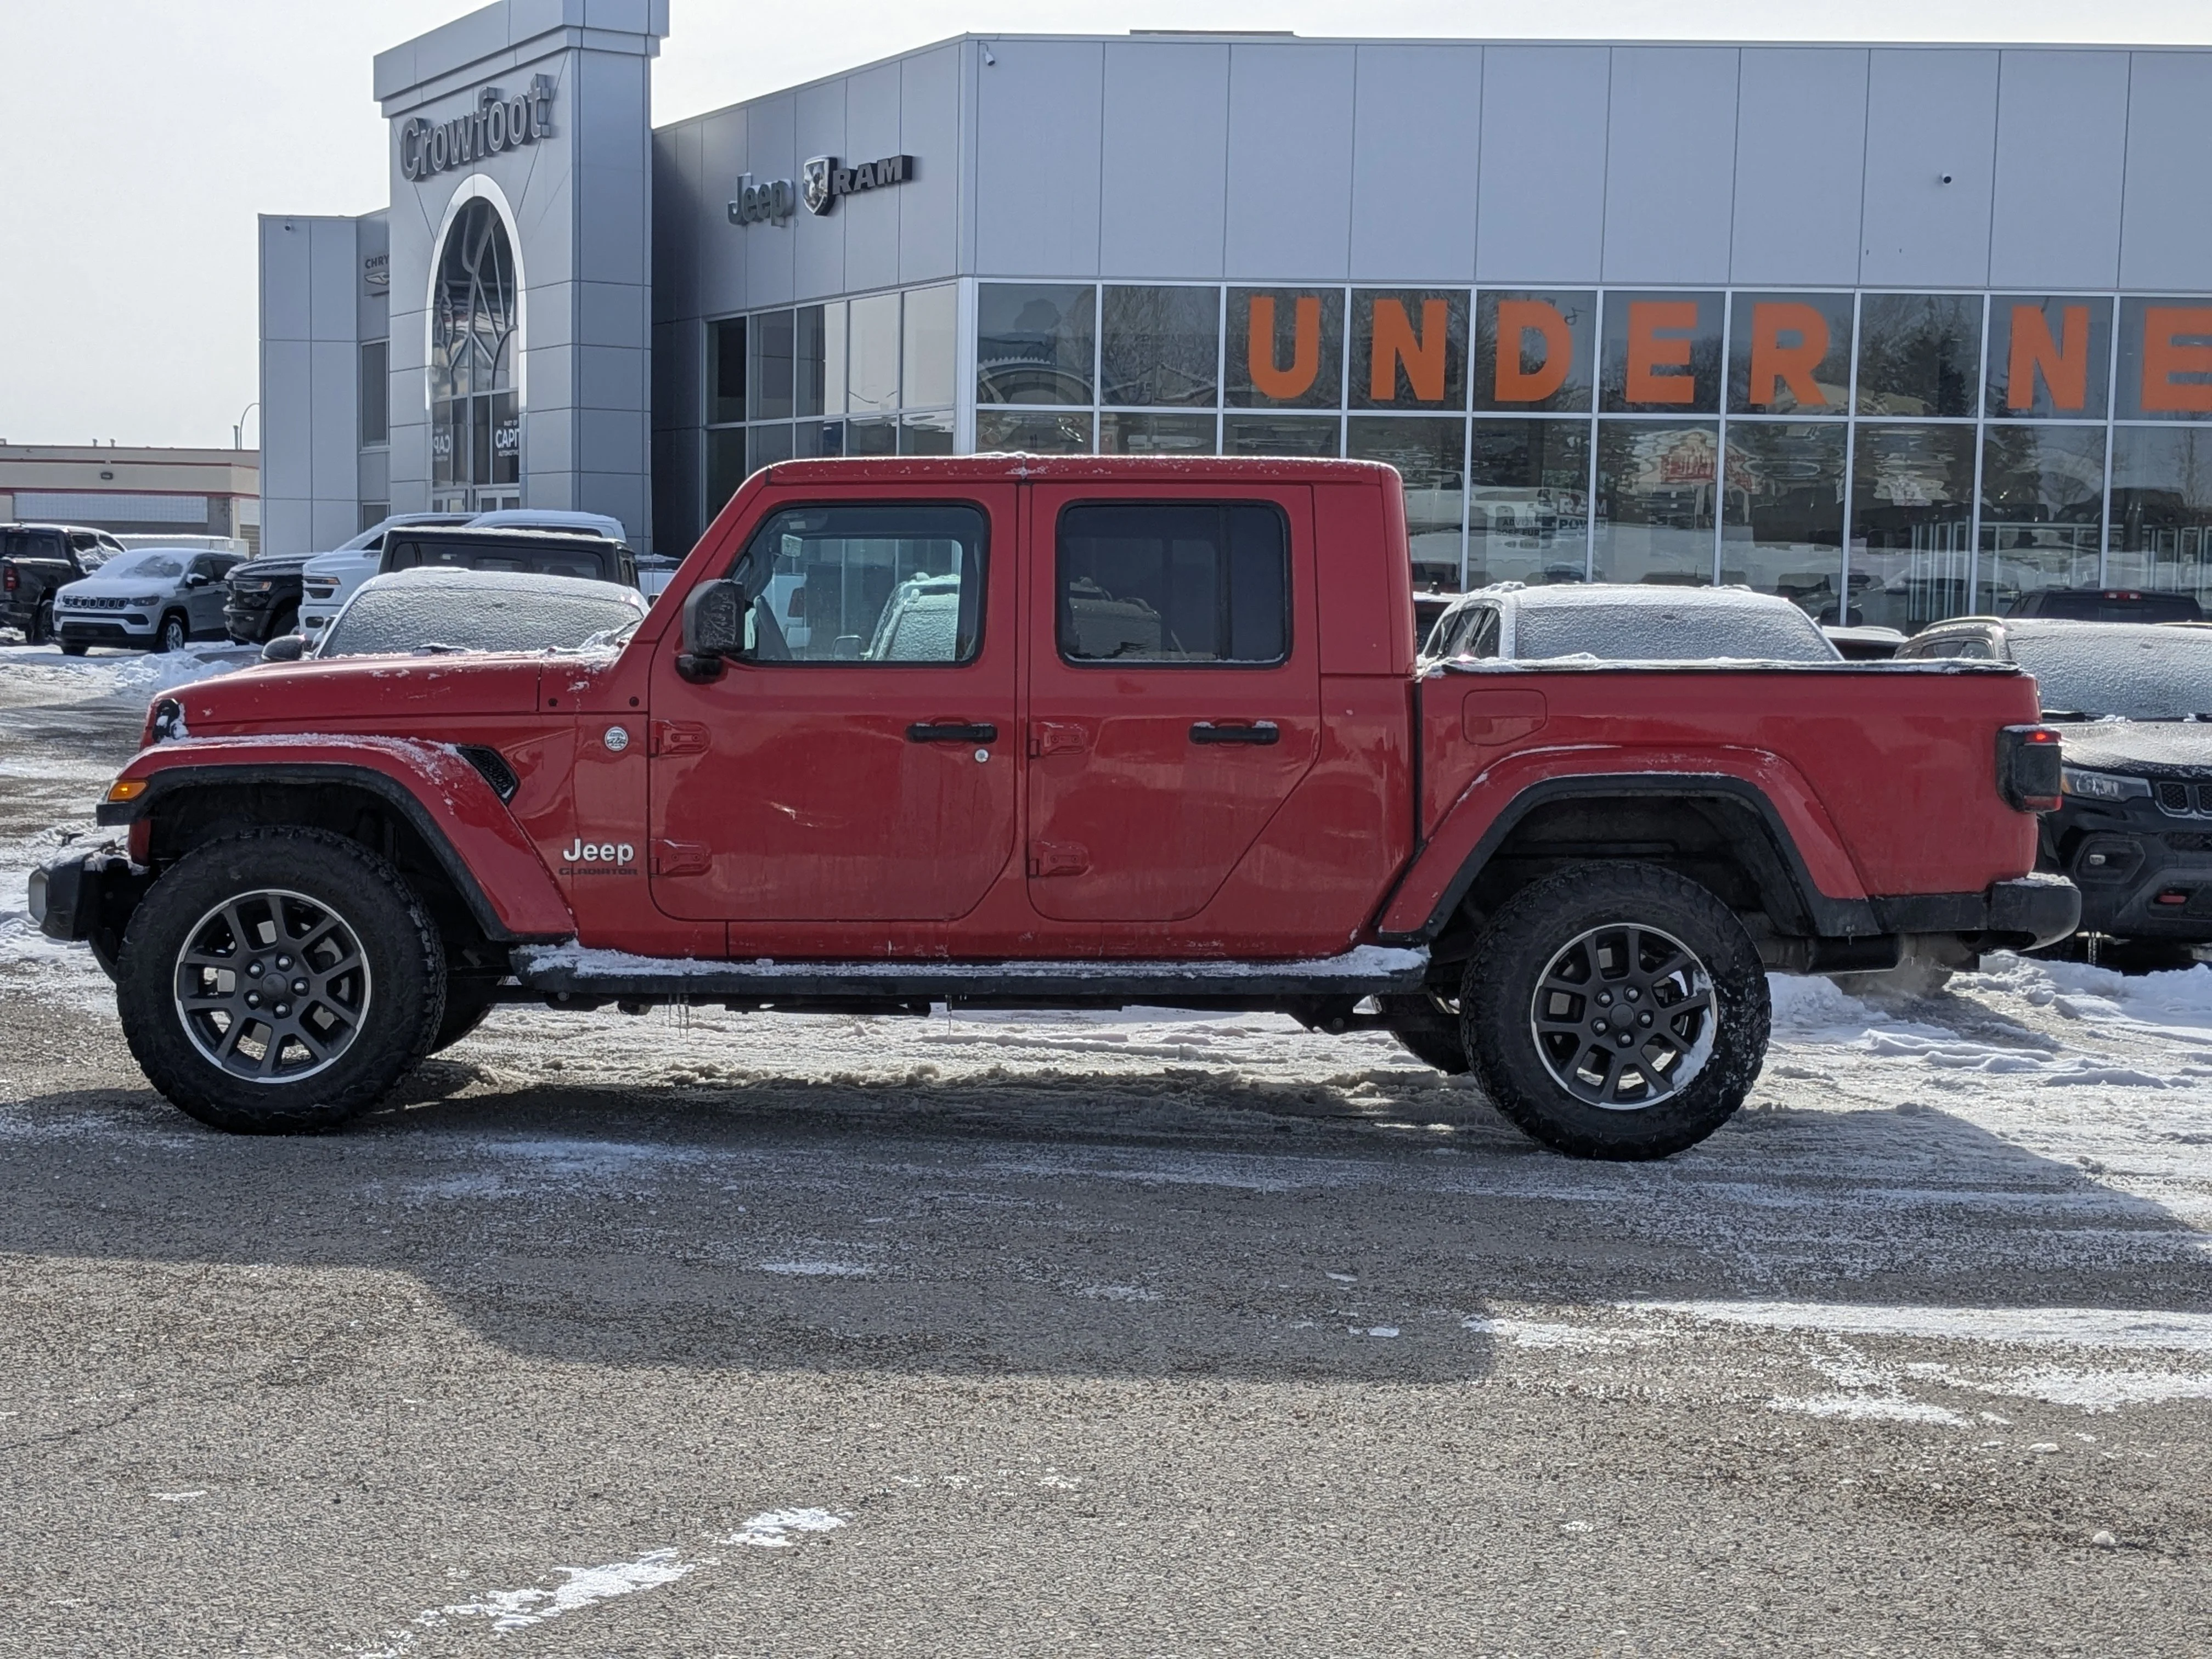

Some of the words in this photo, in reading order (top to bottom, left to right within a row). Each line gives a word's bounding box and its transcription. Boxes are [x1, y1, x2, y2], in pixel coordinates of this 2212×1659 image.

[399, 73, 550, 182] Crowfoot
[727, 171, 794, 228] Jeep
[832, 155, 914, 196] RAM
[1248, 296, 1829, 405] UNDER
[563, 838, 634, 866] Jeep
